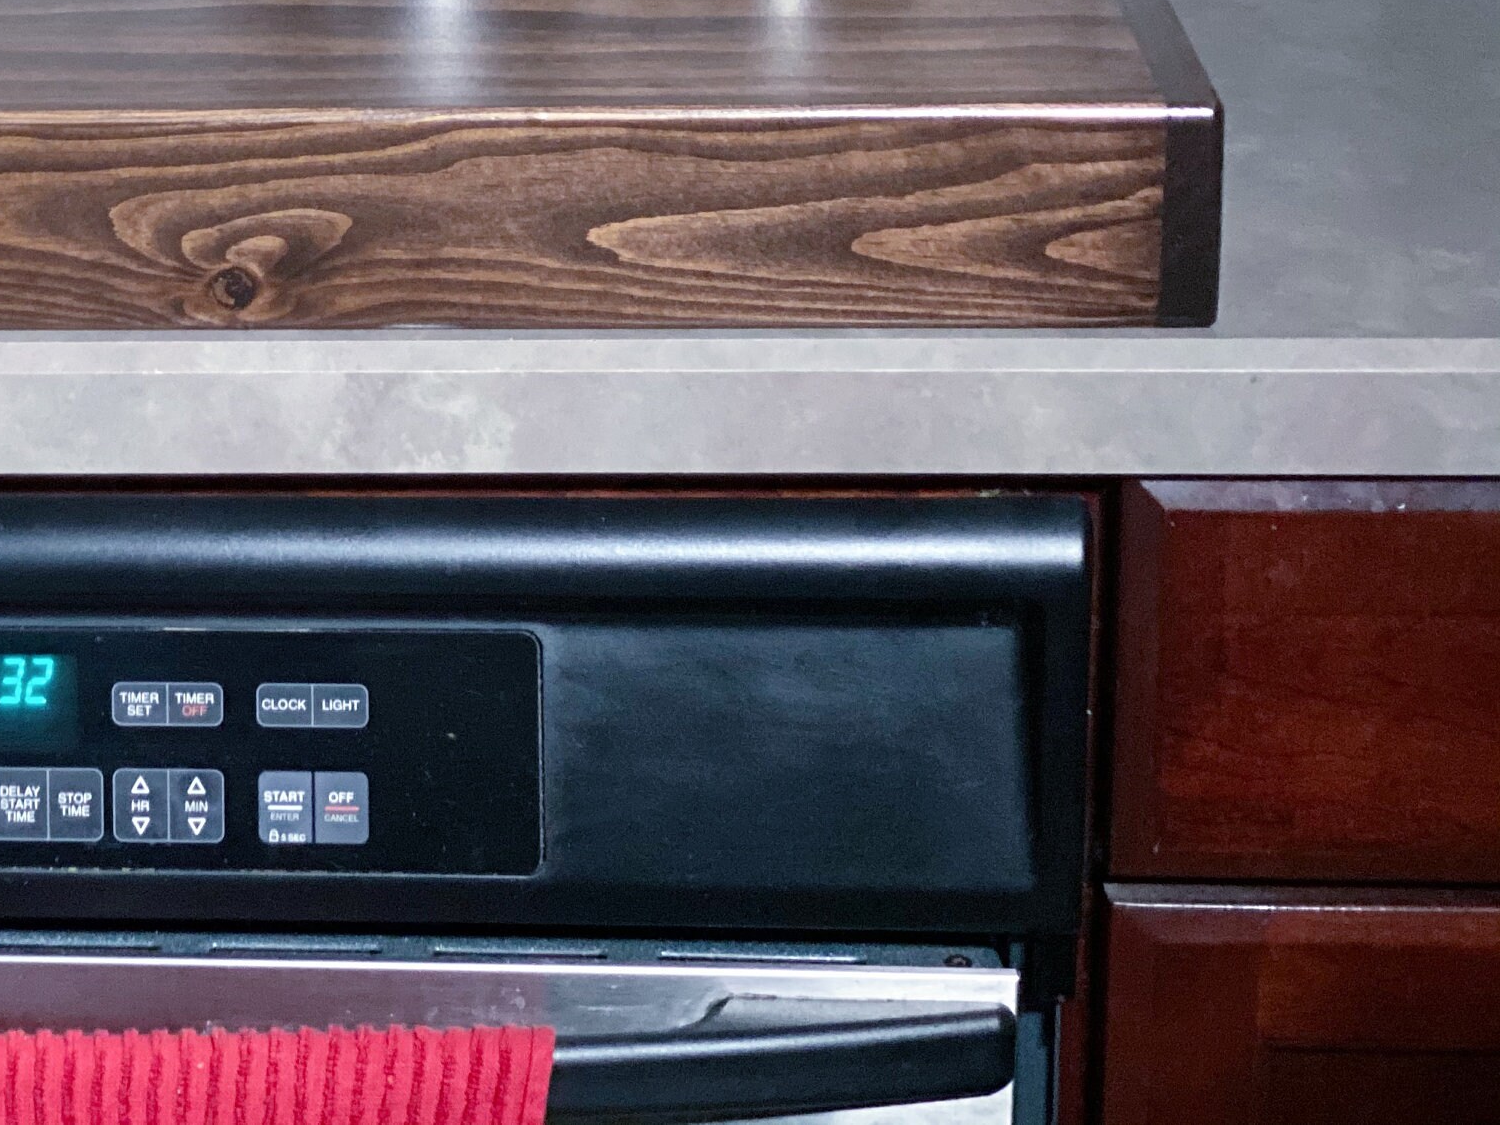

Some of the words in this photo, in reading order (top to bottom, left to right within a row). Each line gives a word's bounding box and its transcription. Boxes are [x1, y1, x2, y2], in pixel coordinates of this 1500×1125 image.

[119, 692, 159, 704] TIMER
[174, 692, 214, 704] TIMER
[127, 704, 152, 716] SET
[261, 698, 306, 711] CLOCK
[321, 699, 360, 712] LIGHT
[182, 705, 207, 717] OFF
[0, 785, 40, 798] DELAY
[263, 790, 305, 803] START
[328, 791, 354, 803] OFF
[0, 798, 40, 811] START
[58, 792, 92, 805] STOP
[60, 805, 90, 817] TIME
[131, 800, 150, 812] HR
[185, 801, 208, 812] MIN
[5, 811, 35, 823] TIME
[270, 812, 300, 821] ENTER
[324, 814, 359, 822] CANCEL
